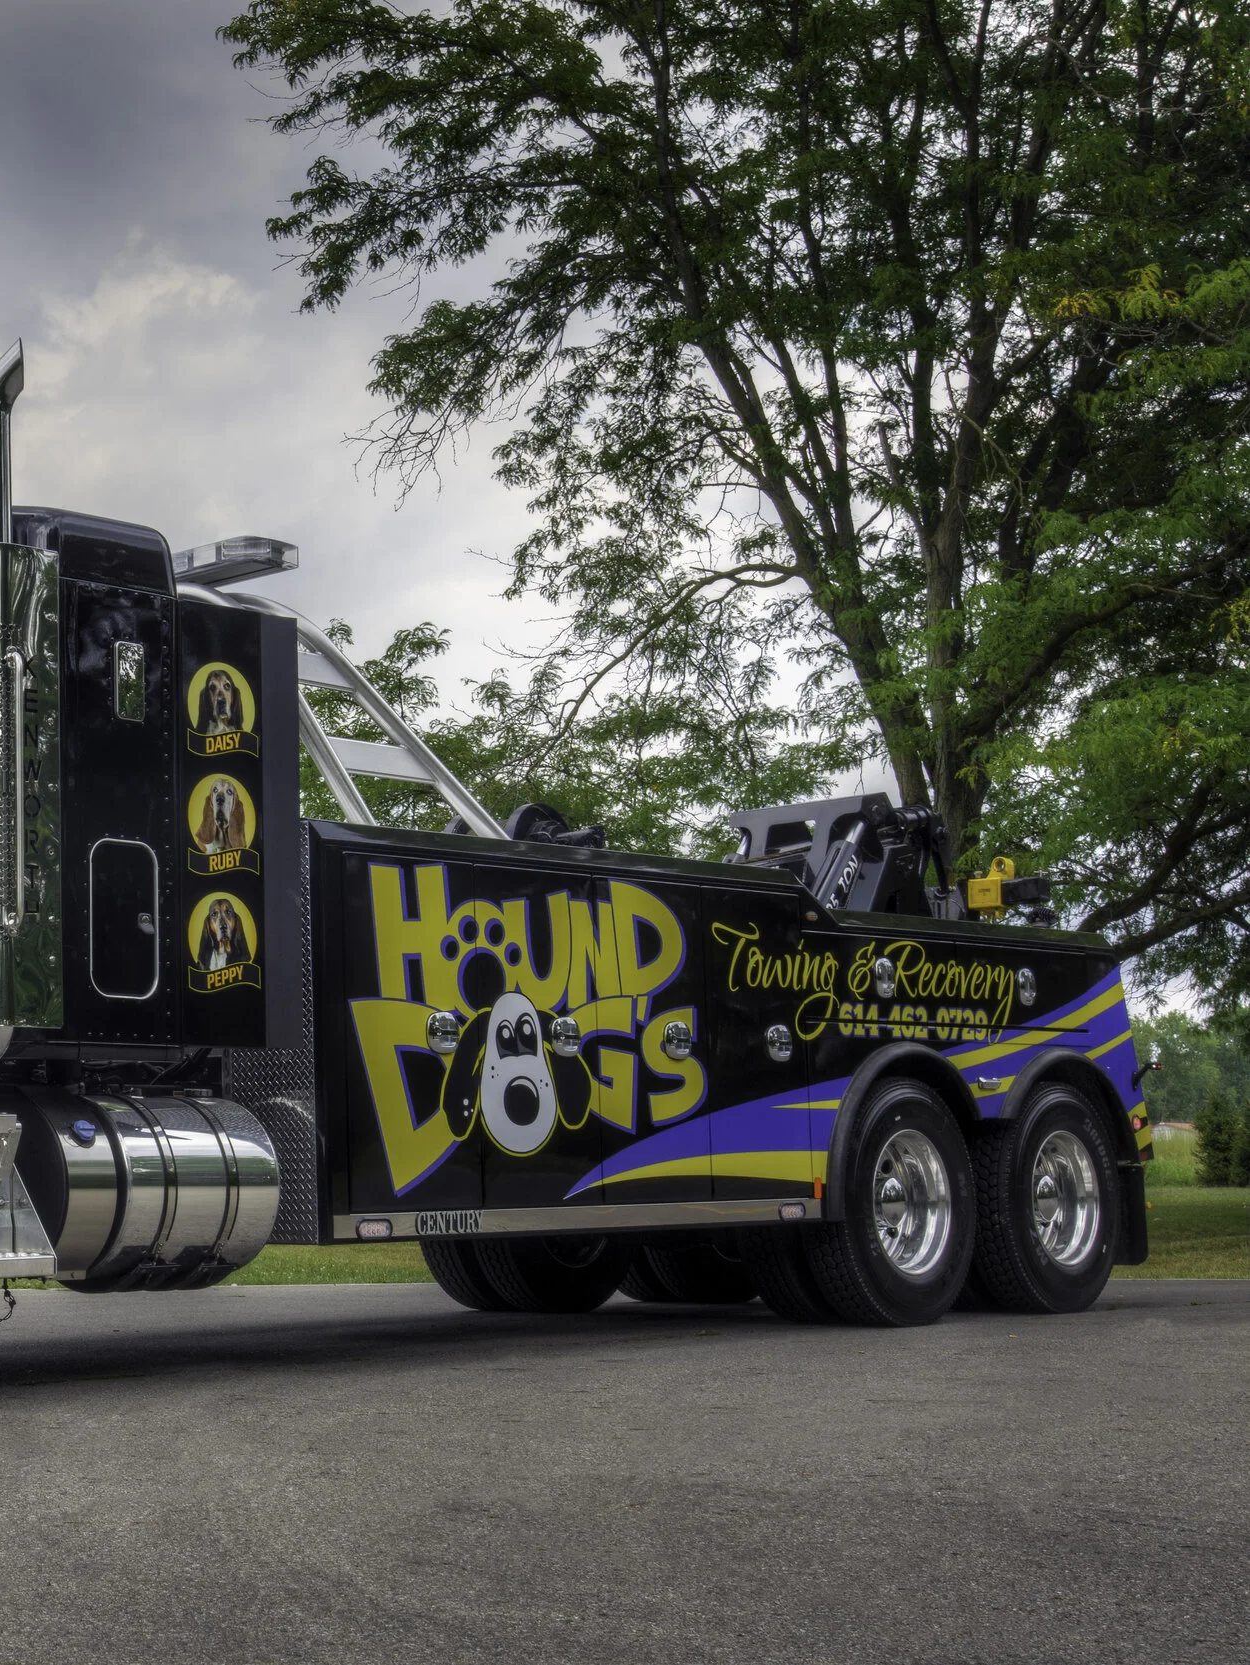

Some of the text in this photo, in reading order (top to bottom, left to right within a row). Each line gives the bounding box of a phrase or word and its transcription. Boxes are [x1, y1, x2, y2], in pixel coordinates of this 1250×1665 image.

[205, 732, 241, 753] DAISY
[208, 853, 242, 873] RUBY
[837, 854, 859, 893] TON
[367, 861, 687, 1014] HOUND
[206, 965, 244, 989] PEPPY
[711, 921, 1014, 1045] Towing & Recovery
[838, 1002, 989, 1041] 614-462-0729
[415, 1209, 484, 1236] CENTURY
